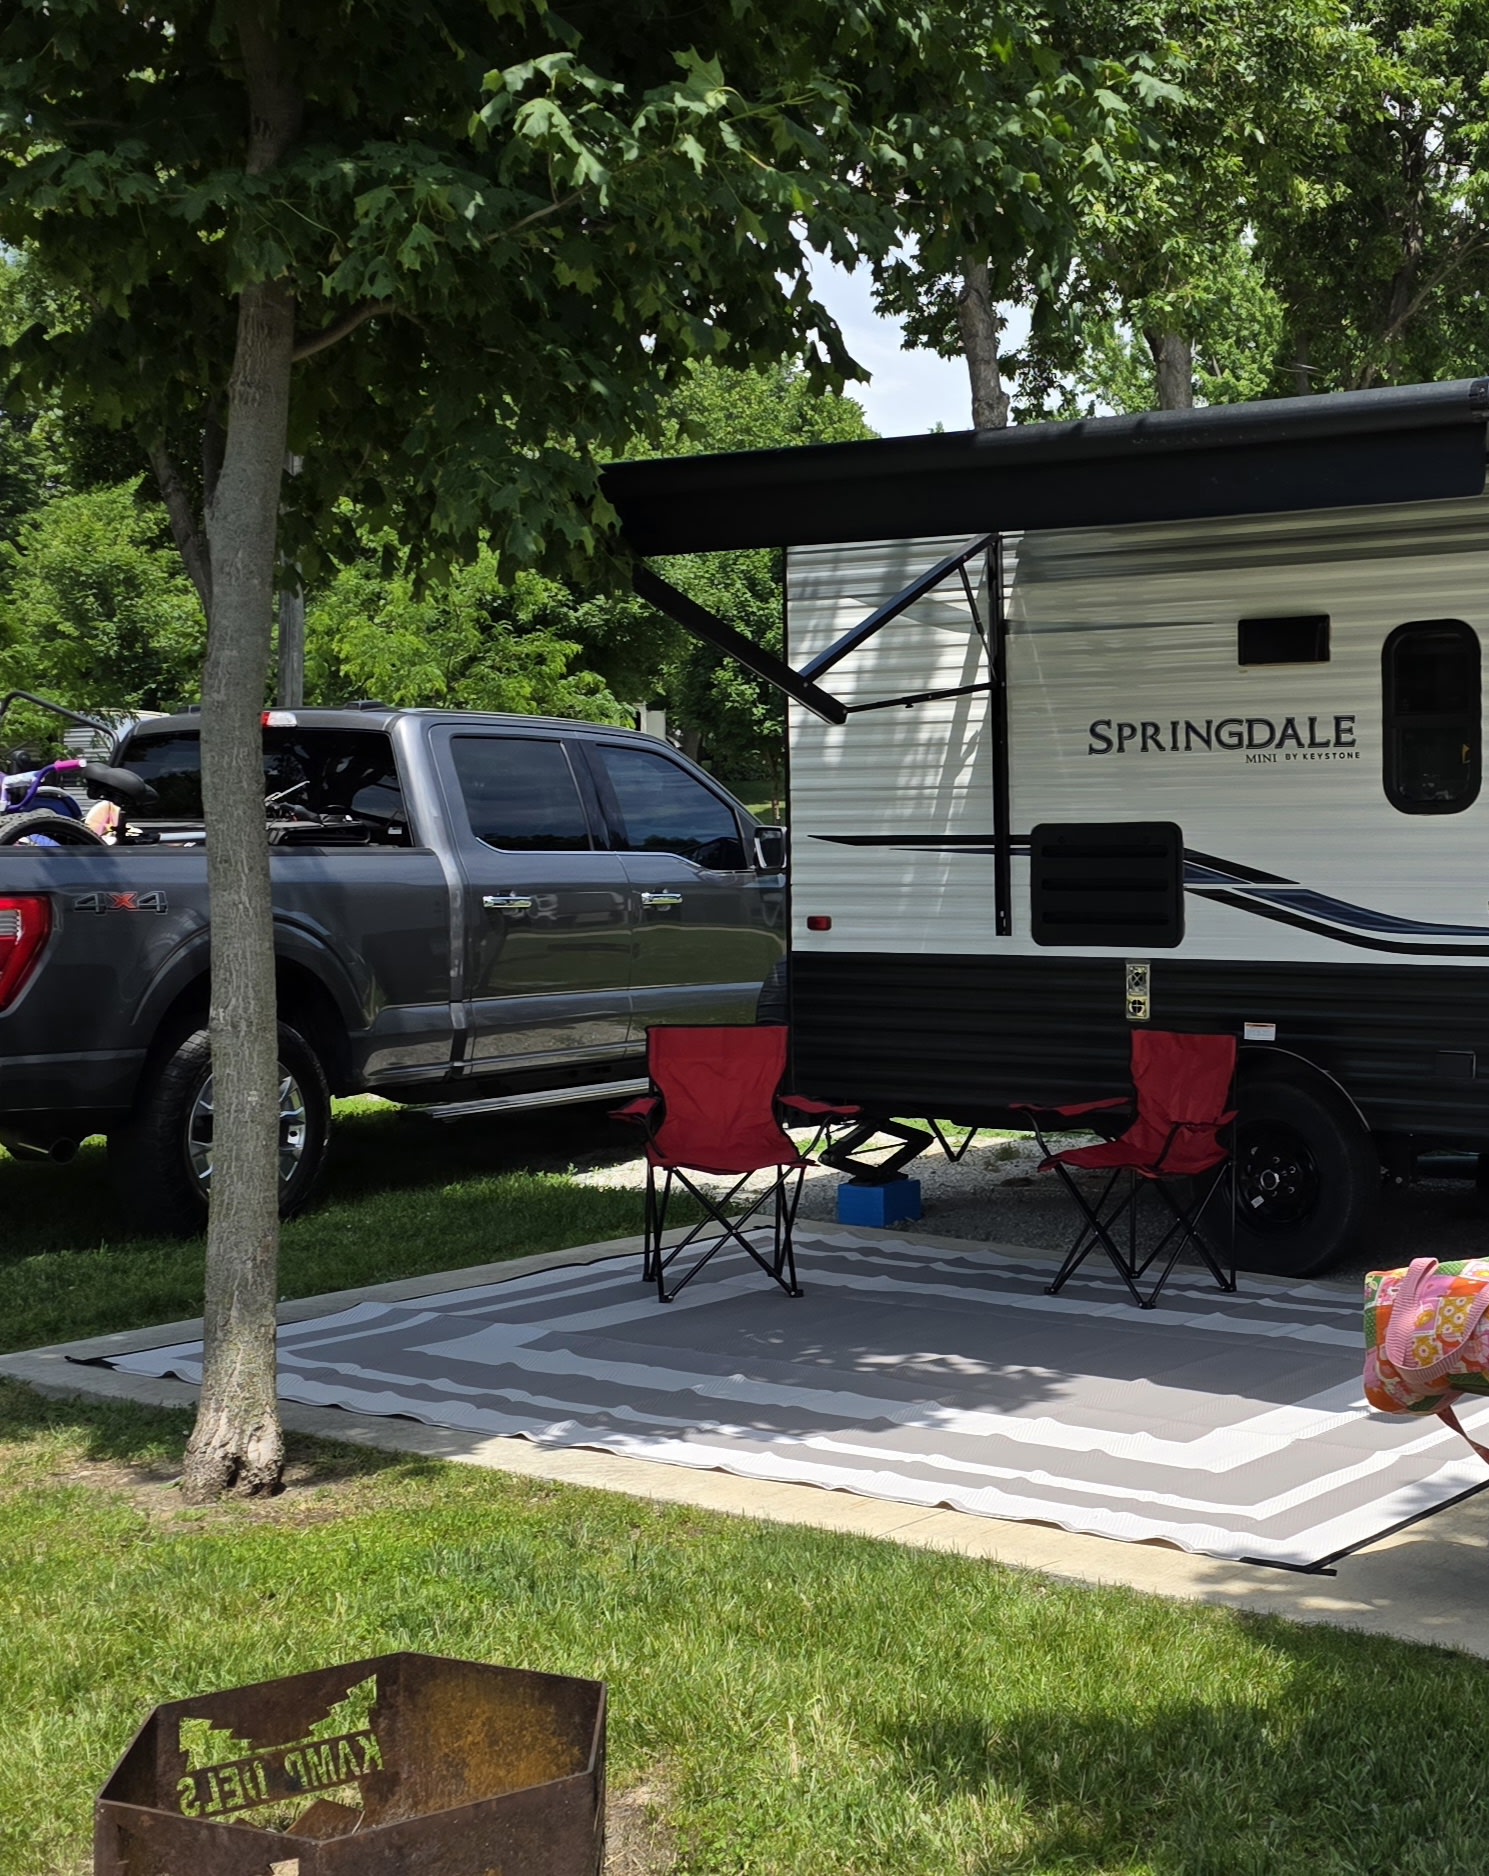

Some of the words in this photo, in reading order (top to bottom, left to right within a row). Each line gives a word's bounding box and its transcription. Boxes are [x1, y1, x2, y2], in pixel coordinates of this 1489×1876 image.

[1088, 714, 1356, 755] SPRINGDALE
[1245, 753, 1277, 763] MINI
[1302, 751, 1361, 760] KEYSTONE
